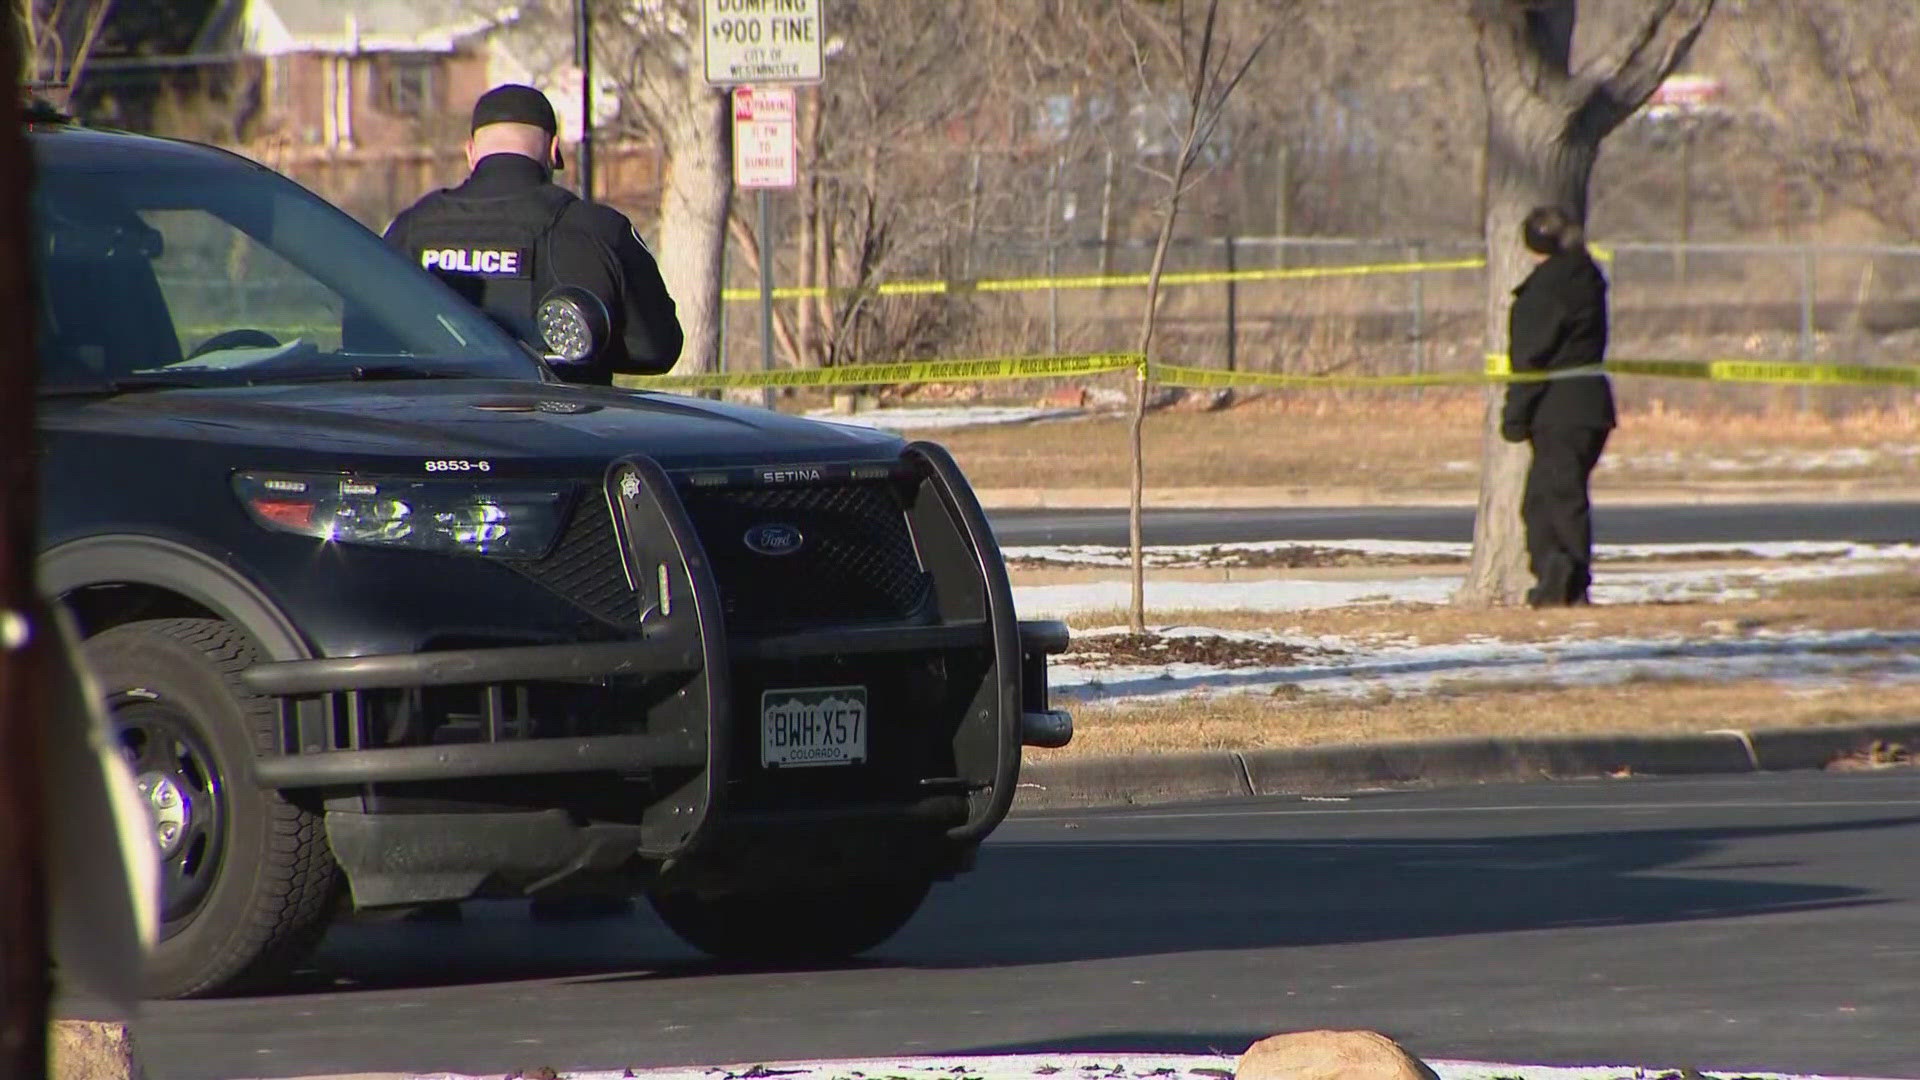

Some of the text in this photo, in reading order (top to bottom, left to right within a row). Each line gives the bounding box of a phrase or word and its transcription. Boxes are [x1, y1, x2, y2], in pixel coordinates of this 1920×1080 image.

[771, 17, 814, 42] FINE
[422, 249, 518, 274] POLICE
[425, 460, 491, 472] 8853-6
[763, 470, 820, 483] SETINA
[761, 529, 791, 547] Ford
[789, 747, 841, 761] COLORADO
